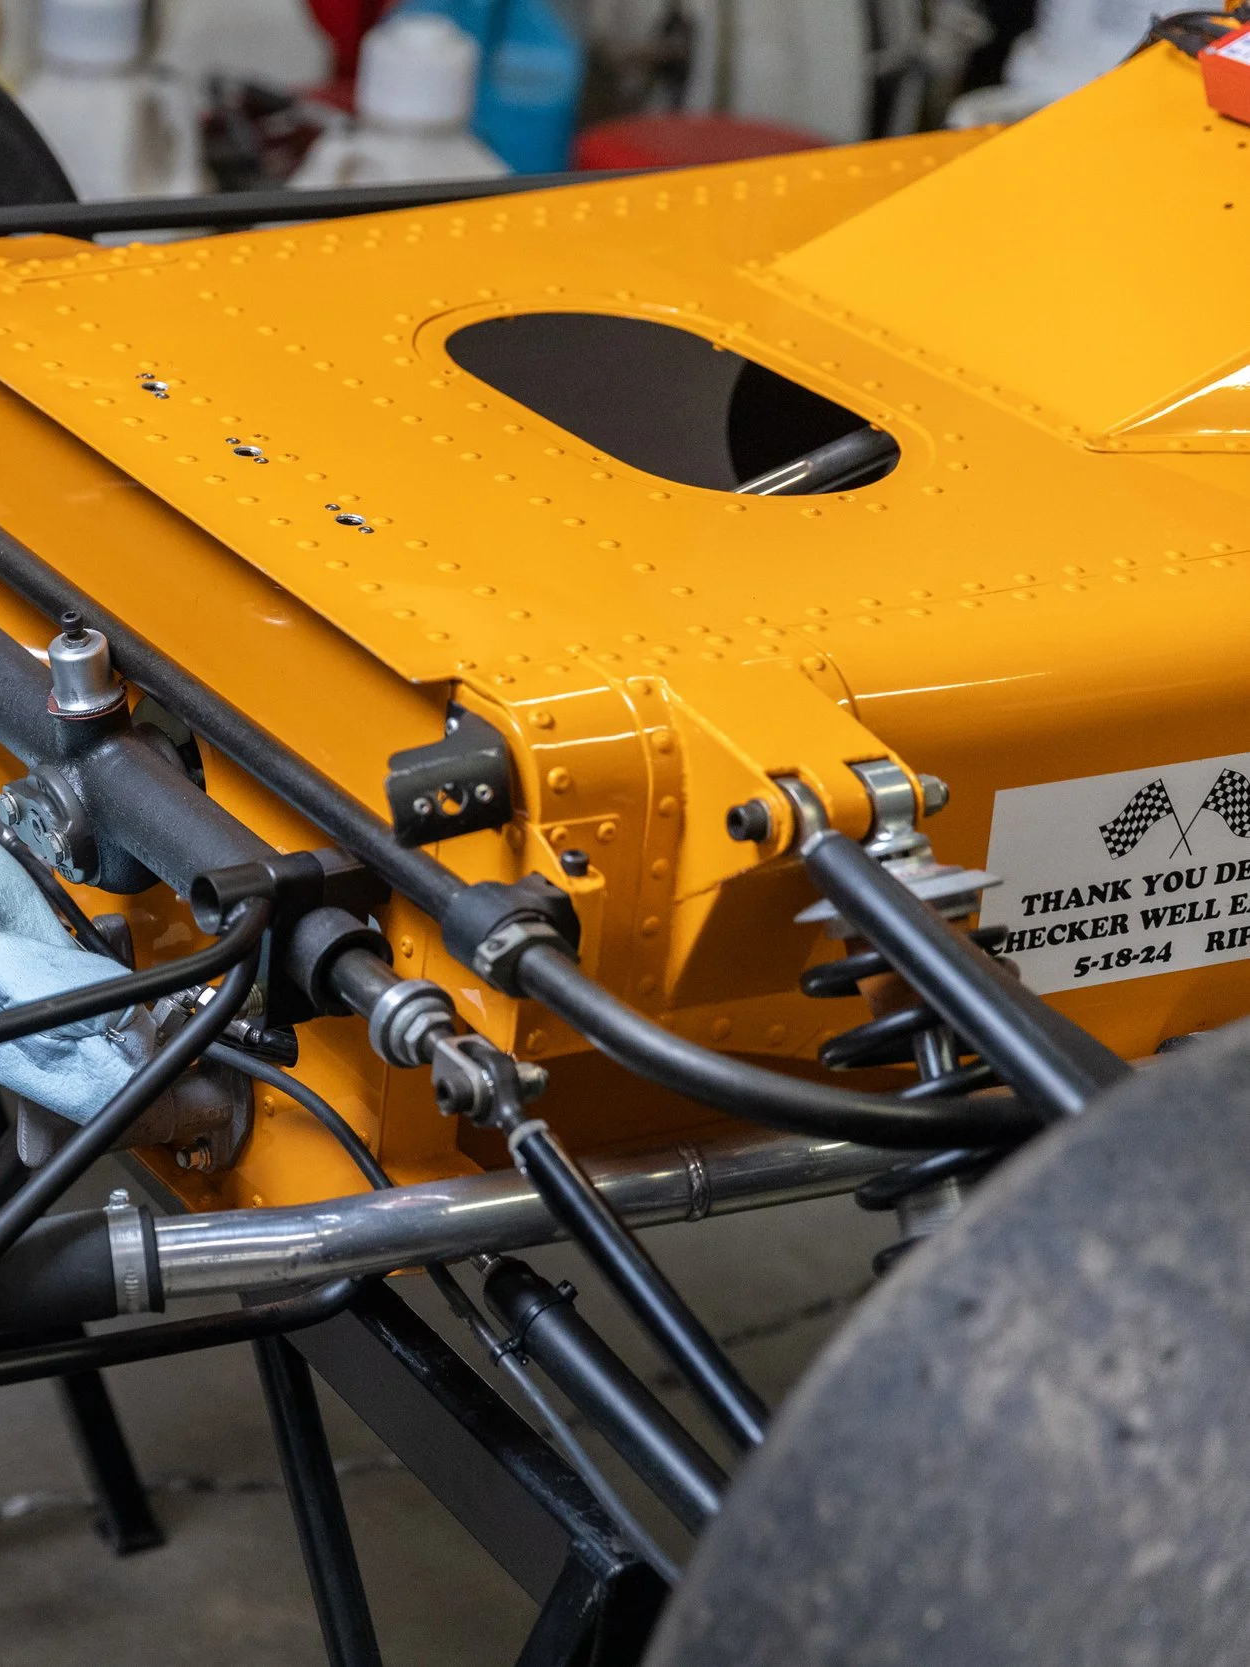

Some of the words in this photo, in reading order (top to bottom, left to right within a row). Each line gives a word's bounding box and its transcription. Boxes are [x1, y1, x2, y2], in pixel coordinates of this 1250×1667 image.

[1021, 878, 1132, 916] THANK
[1142, 866, 1208, 896] YOU
[1140, 898, 1221, 930] WELL
[1228, 893, 1250, 916] E
[1073, 941, 1173, 977] 5-18-24
